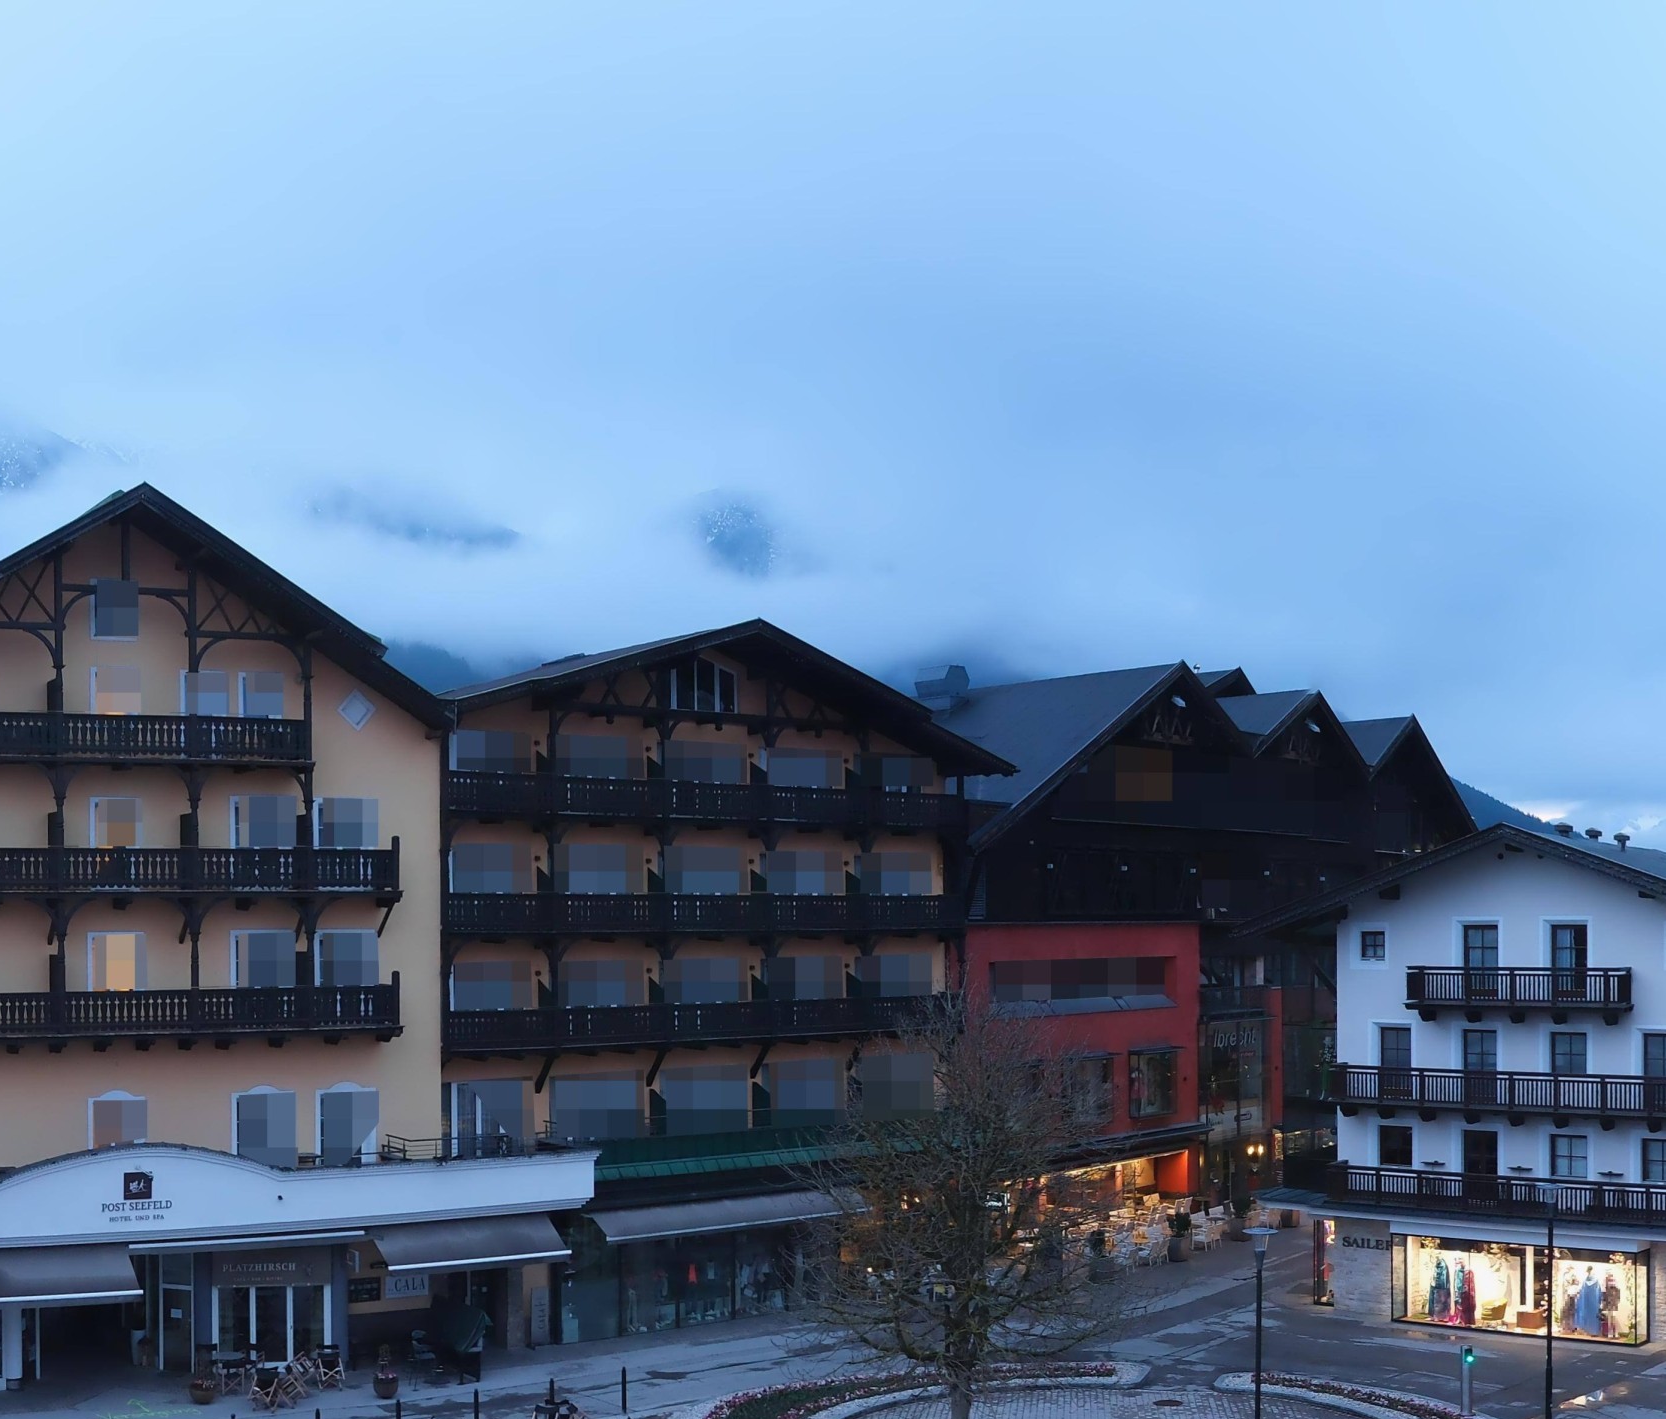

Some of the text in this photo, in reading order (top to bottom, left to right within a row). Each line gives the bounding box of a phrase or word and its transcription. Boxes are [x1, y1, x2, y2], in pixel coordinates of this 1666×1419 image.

[101, 1200, 172, 1212] POST SEEFELD
[222, 1262, 296, 1272] PLATZHIRSCH
